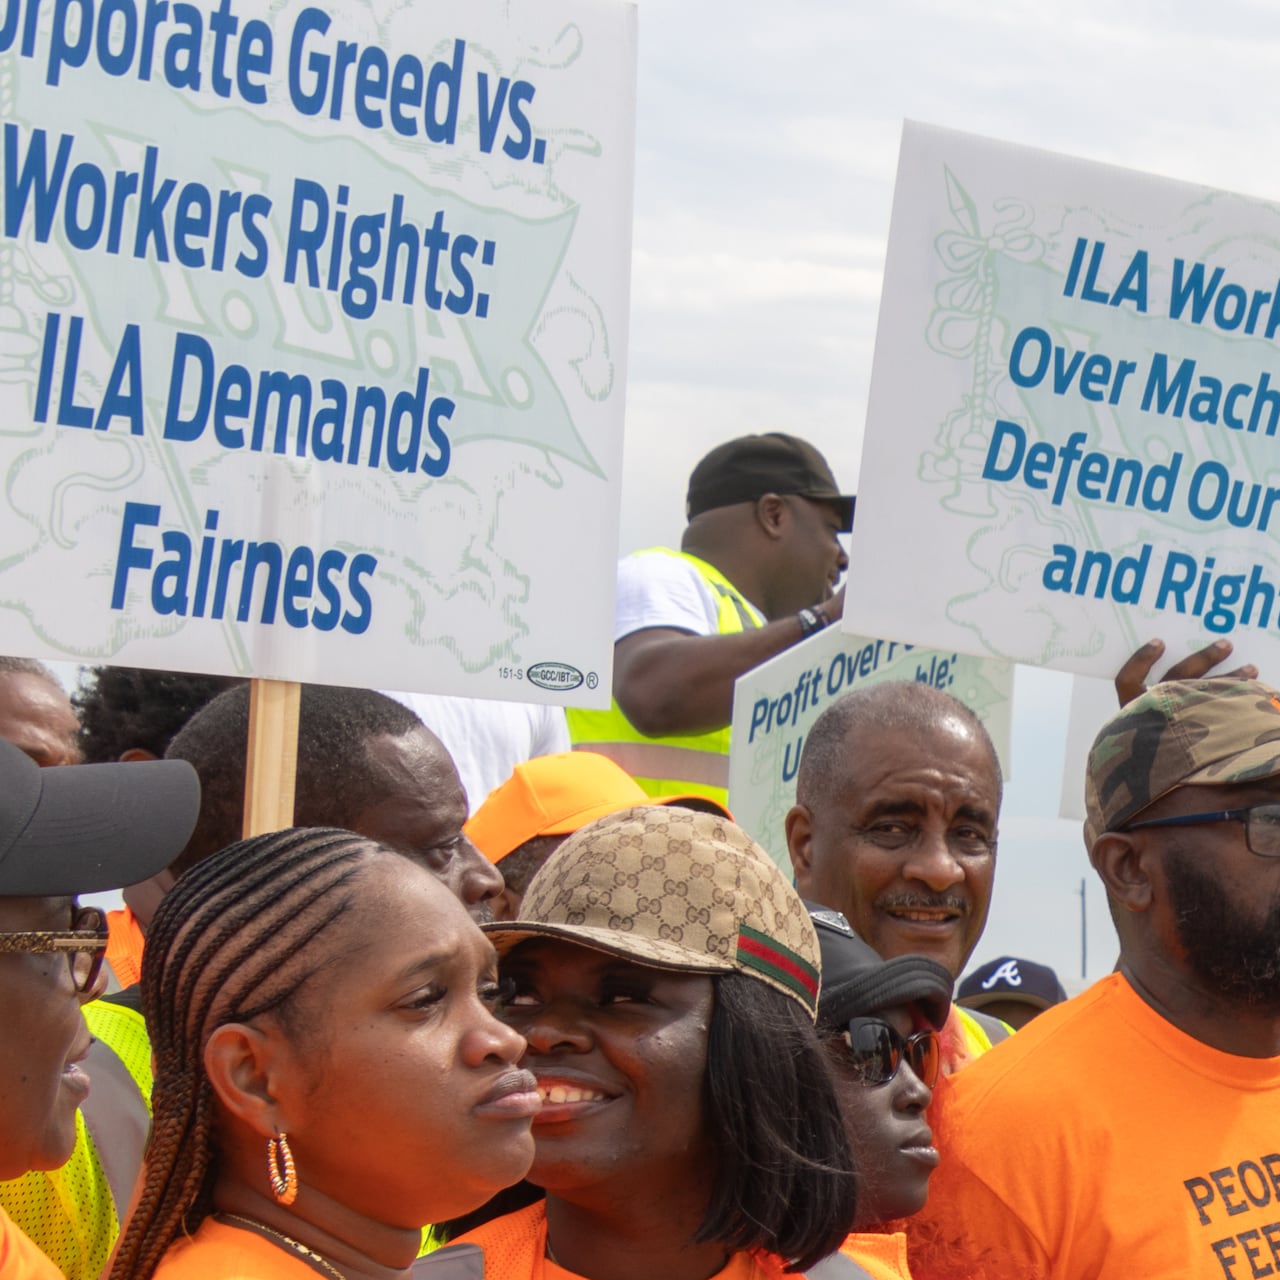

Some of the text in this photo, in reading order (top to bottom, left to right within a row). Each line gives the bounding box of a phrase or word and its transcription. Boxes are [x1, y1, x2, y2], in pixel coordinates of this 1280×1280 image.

[288, 7, 465, 144] Greed
[478, 72, 546, 164] vs.
[5, 124, 496, 320] Workers Rights:
[1063, 238, 1148, 313] ILA
[34, 313, 455, 477] ILA Demands
[1009, 327, 1137, 405] Over
[982, 420, 1183, 513] Defend
[112, 502, 377, 635] Fairness
[1042, 542, 1148, 606] and
[499, 668, 523, 680] 151-S
[750, 673, 821, 741] Profit
[828, 641, 882, 694] Over
[982, 960, 1022, 989] A
